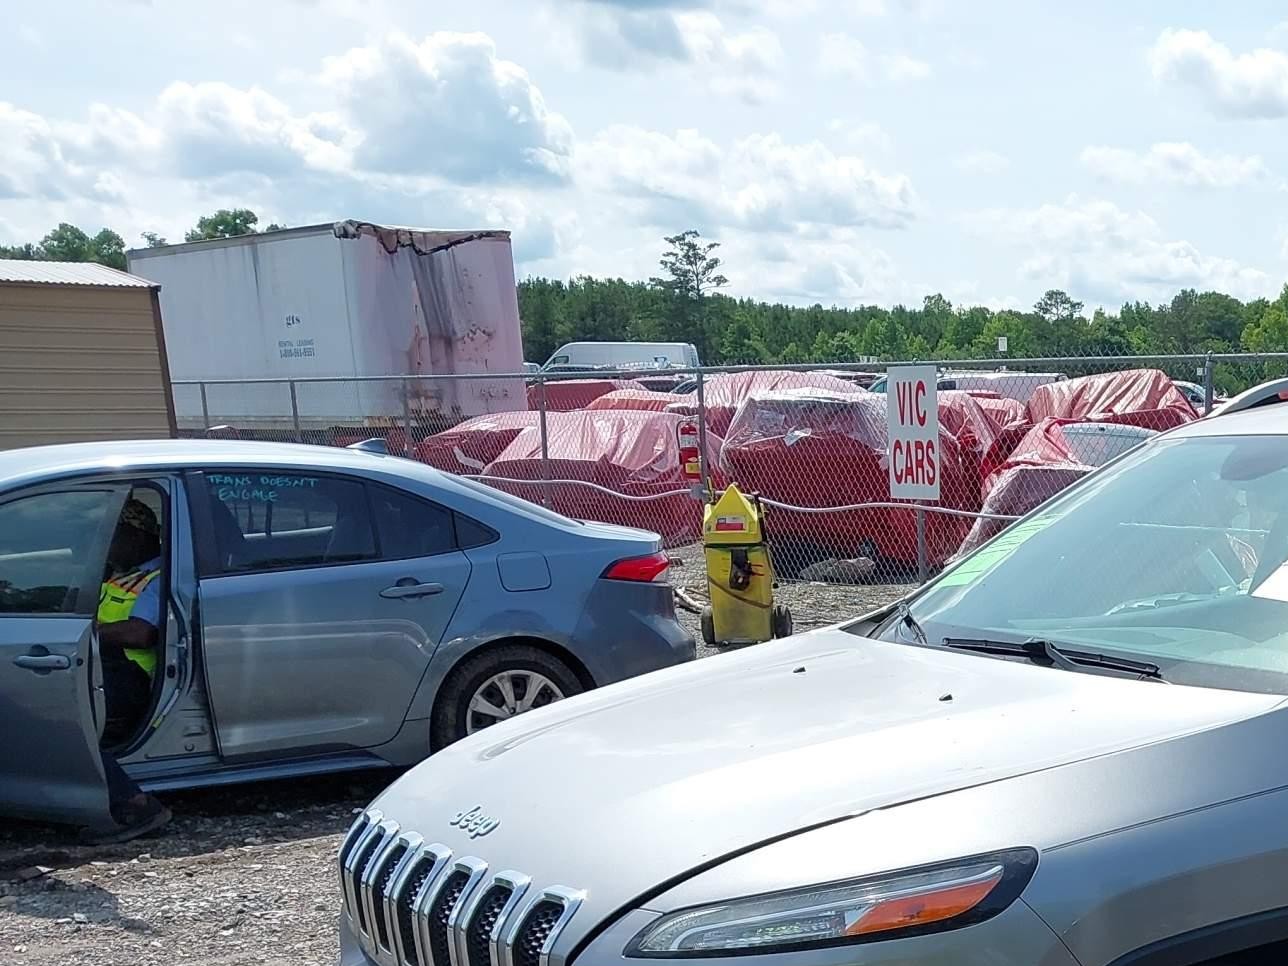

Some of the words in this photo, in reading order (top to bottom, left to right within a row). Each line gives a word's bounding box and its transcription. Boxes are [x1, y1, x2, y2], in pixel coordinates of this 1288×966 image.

[896, 380, 927, 427] VIC
[206, 475, 252, 487] TRANS
[893, 439, 936, 486] CARS
[449, 805, 501, 840] Jeep
